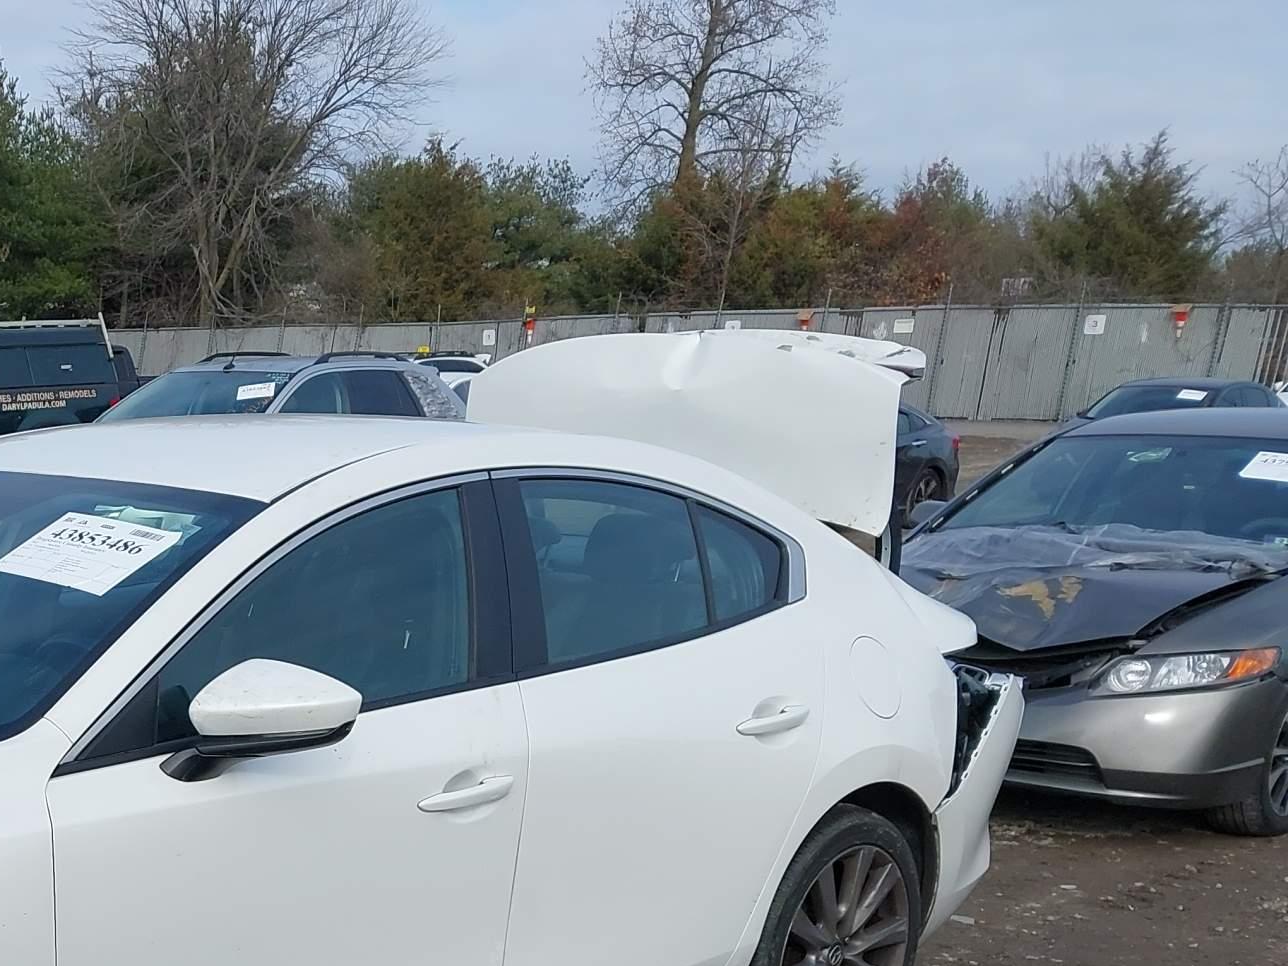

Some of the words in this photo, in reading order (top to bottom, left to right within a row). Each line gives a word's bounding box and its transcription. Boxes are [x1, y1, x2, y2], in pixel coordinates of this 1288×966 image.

[16, 391, 55, 402] ADDITIONS
[59, 389, 97, 399] REMODELS
[2, 400, 66, 411] DARYLPADULA.COM
[52, 528, 148, 554] 43853486
